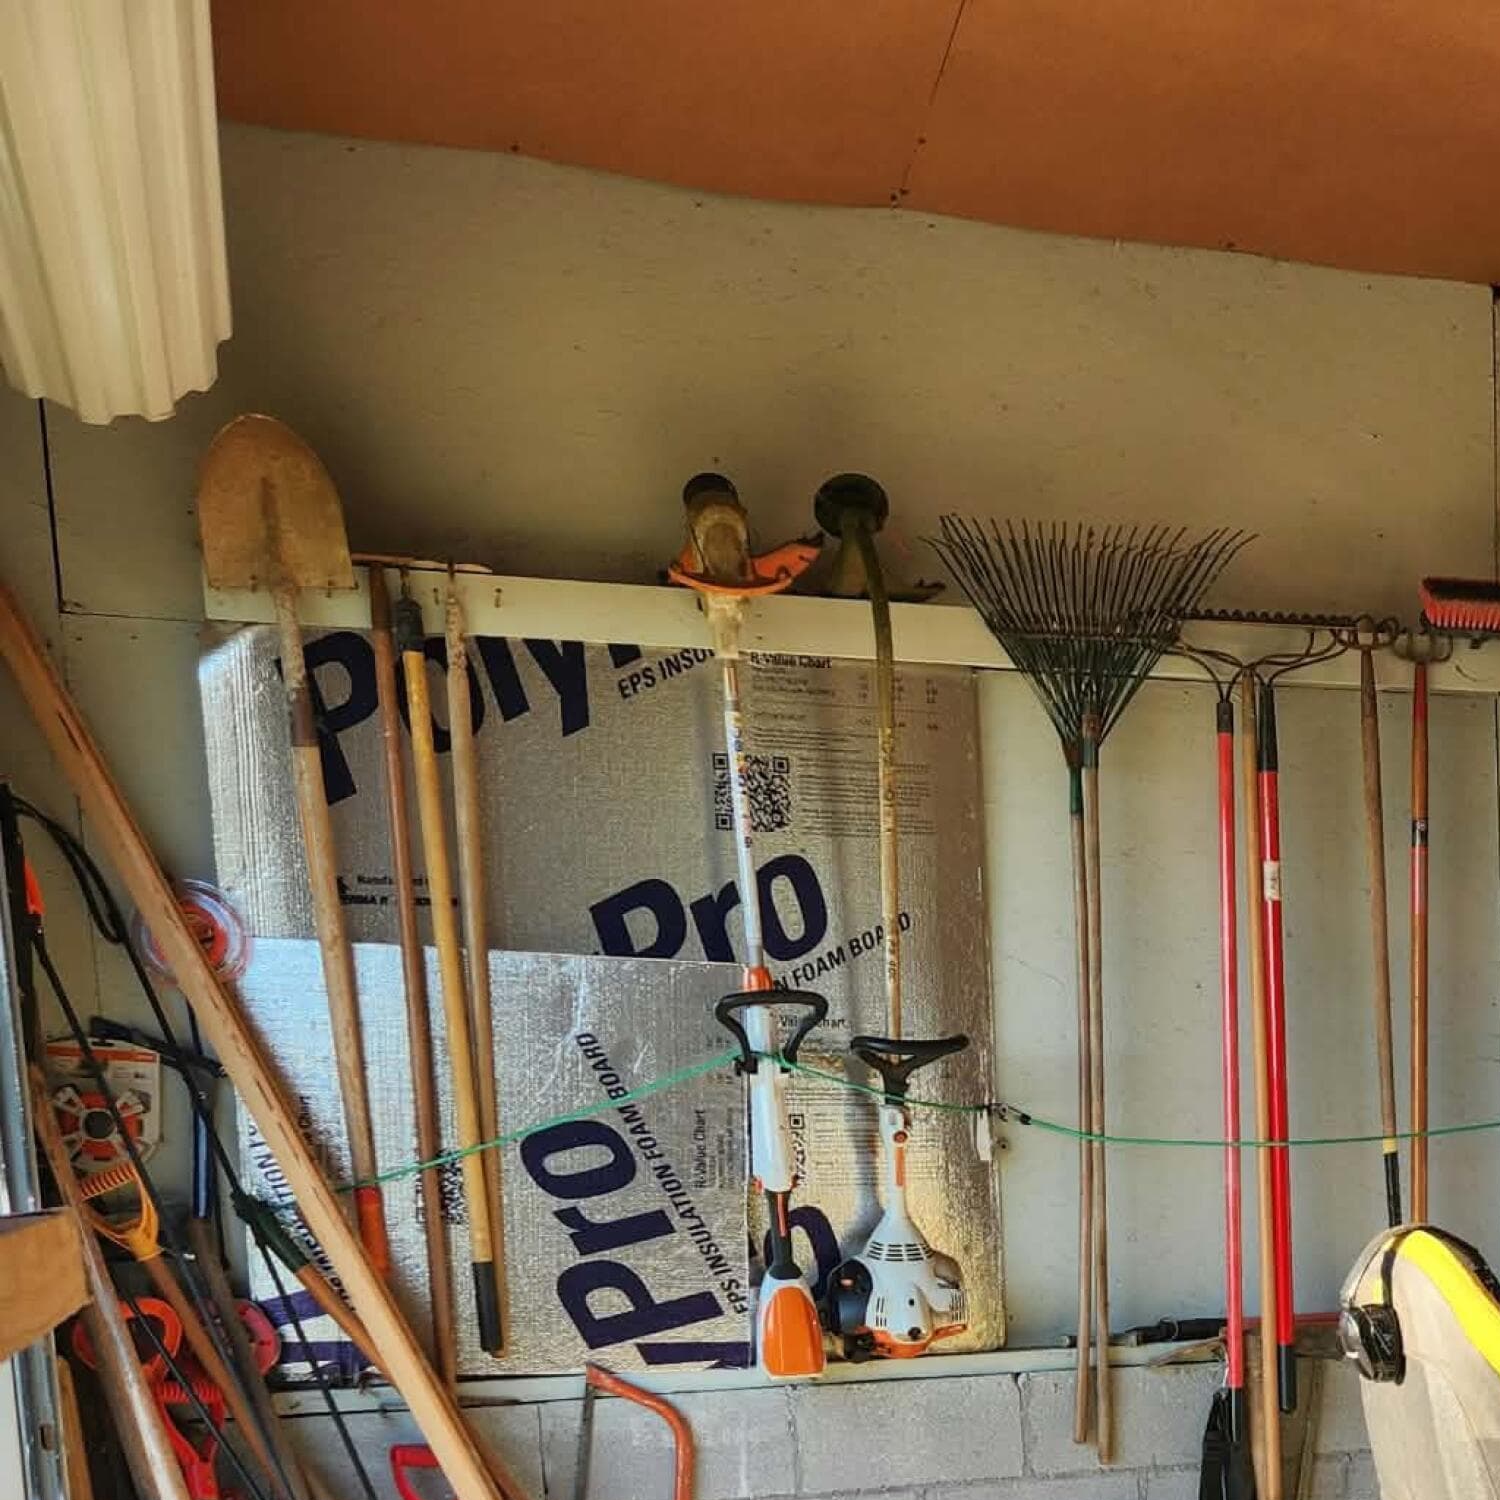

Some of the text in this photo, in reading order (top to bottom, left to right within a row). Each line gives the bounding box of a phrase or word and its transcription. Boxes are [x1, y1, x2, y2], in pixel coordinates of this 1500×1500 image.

[617, 667, 656, 699] EPS
[589, 856, 828, 962] Pro
[792, 949, 847, 988] FOAM
[849, 911, 911, 957] BOAD
[575, 1031, 629, 1101] BOARD
[618, 1103, 663, 1164] FOAM
[519, 1118, 725, 1350] Pro
[655, 1164, 732, 1277] INSULATION
